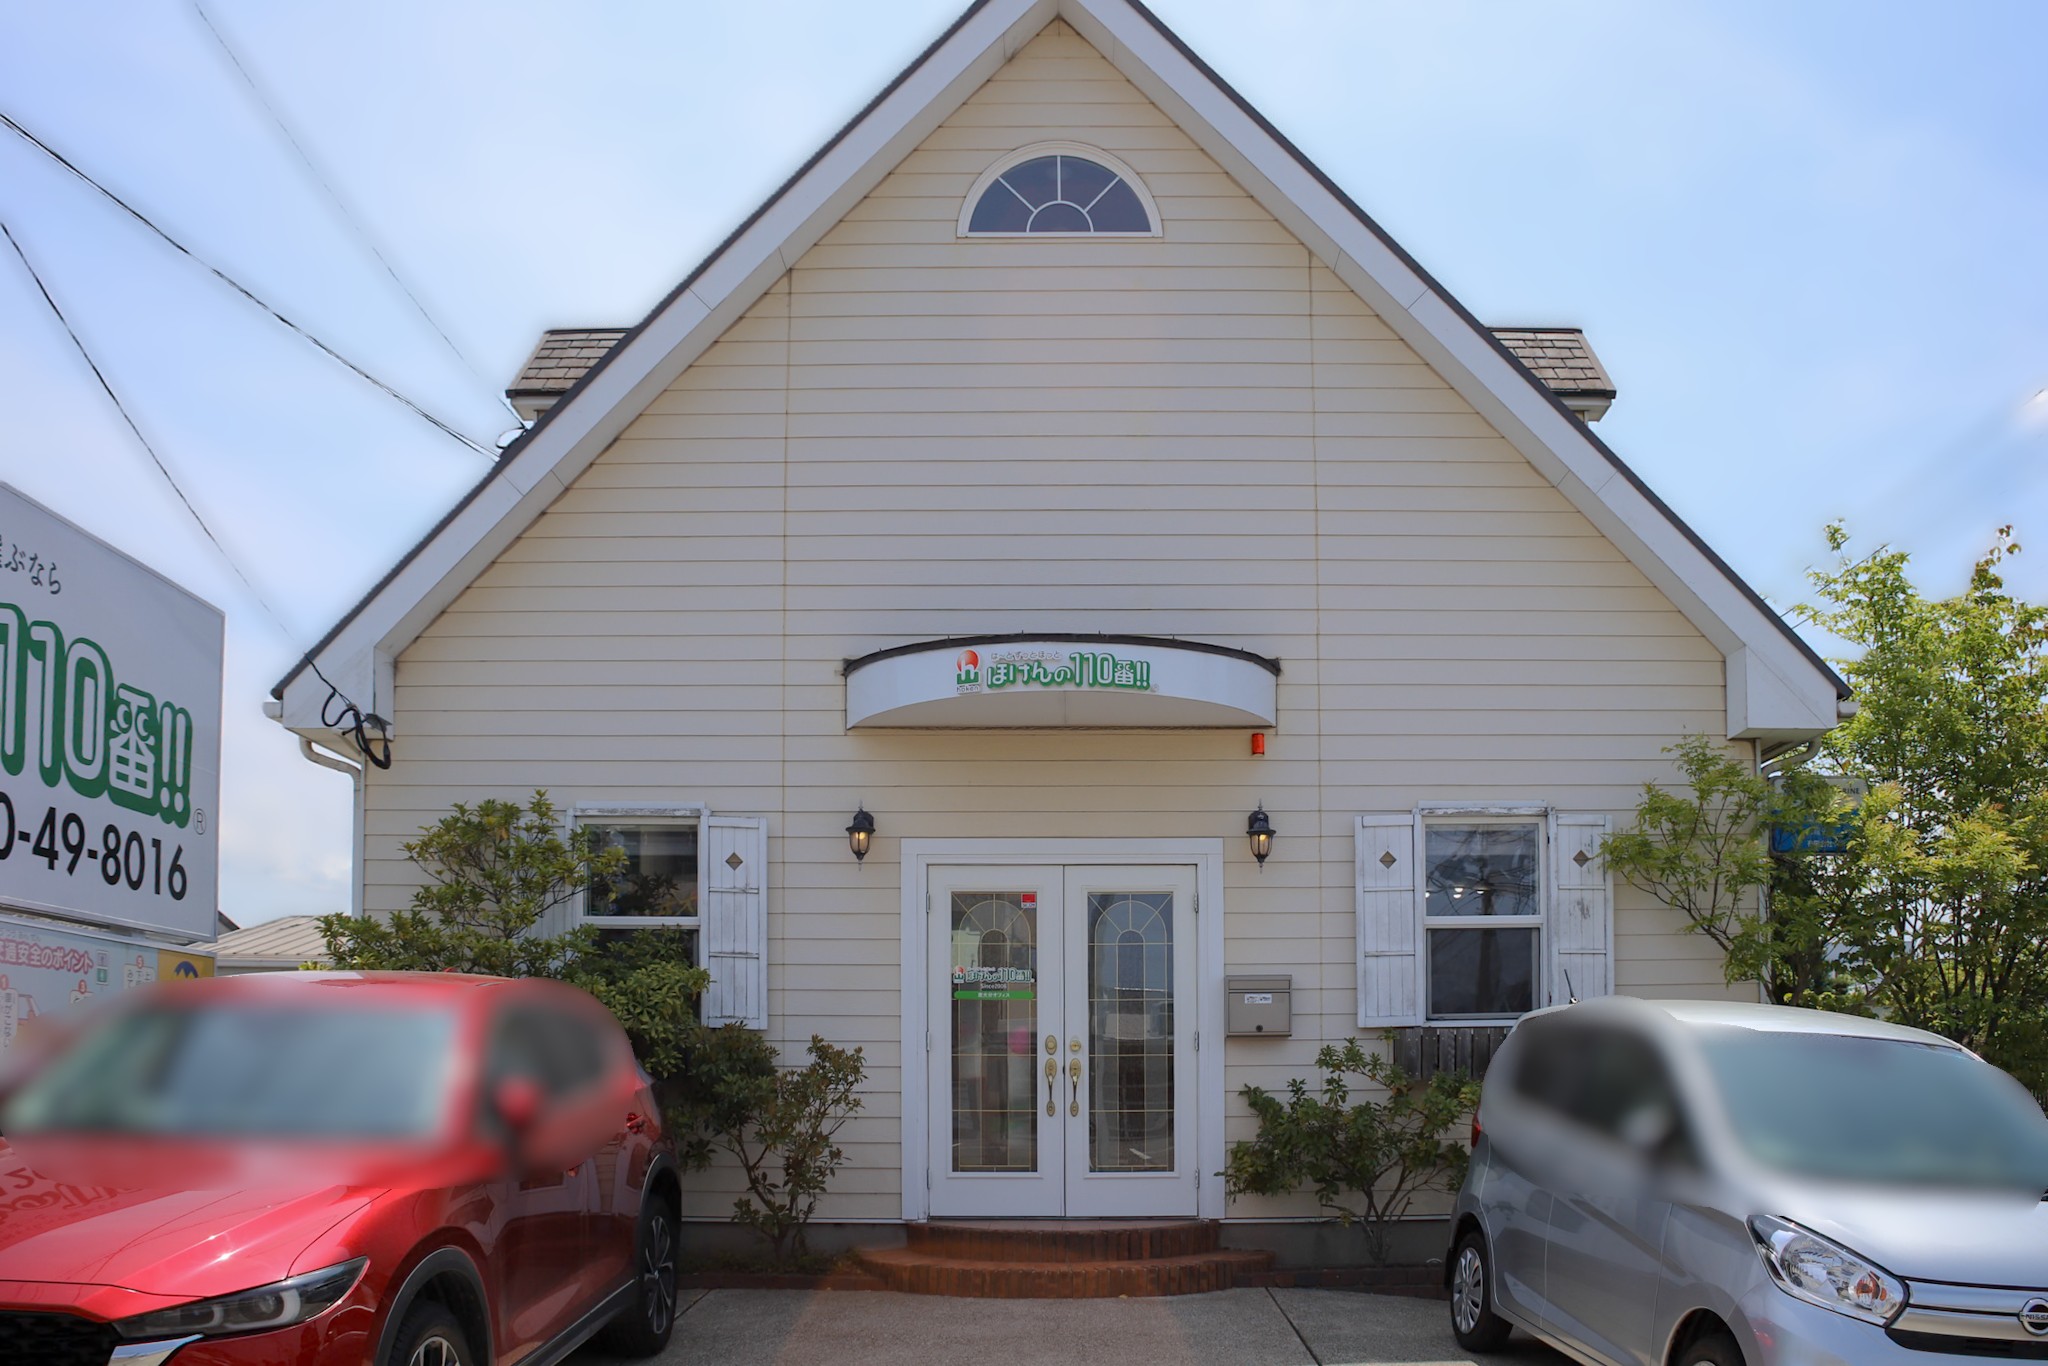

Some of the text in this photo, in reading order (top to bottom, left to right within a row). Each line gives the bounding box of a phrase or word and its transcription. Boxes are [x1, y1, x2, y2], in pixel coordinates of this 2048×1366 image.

[0, 535, 61, 595] ぶなら
[956, 685, 979, 693] hoken
[987, 652, 1150, 690] ほけんの110番!!
